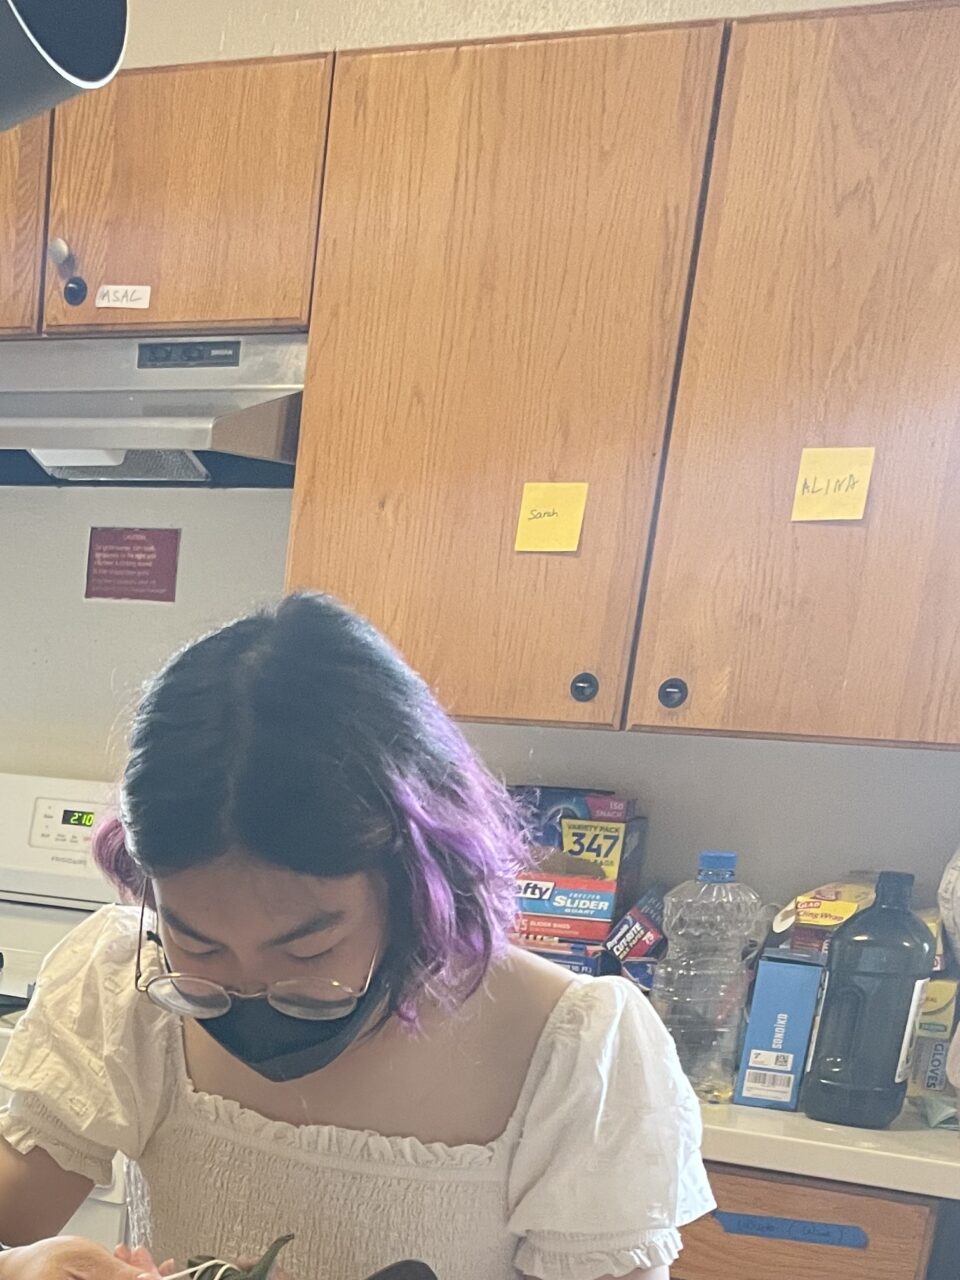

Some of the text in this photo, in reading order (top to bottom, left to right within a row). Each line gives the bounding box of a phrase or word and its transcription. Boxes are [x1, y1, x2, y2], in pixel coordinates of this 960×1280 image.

[527, 507, 559, 521] Sarah
[567, 824, 621, 834] VARIETY PACK
[568, 832, 621, 858] 347
[514, 882, 551, 900] efty
[552, 894, 610, 912] SLIDER
[796, 899, 821, 909] GLAD
[563, 907, 596, 916] QUART
[796, 908, 845, 922] Cling Wrap
[926, 1042, 945, 1089] GLOVES
